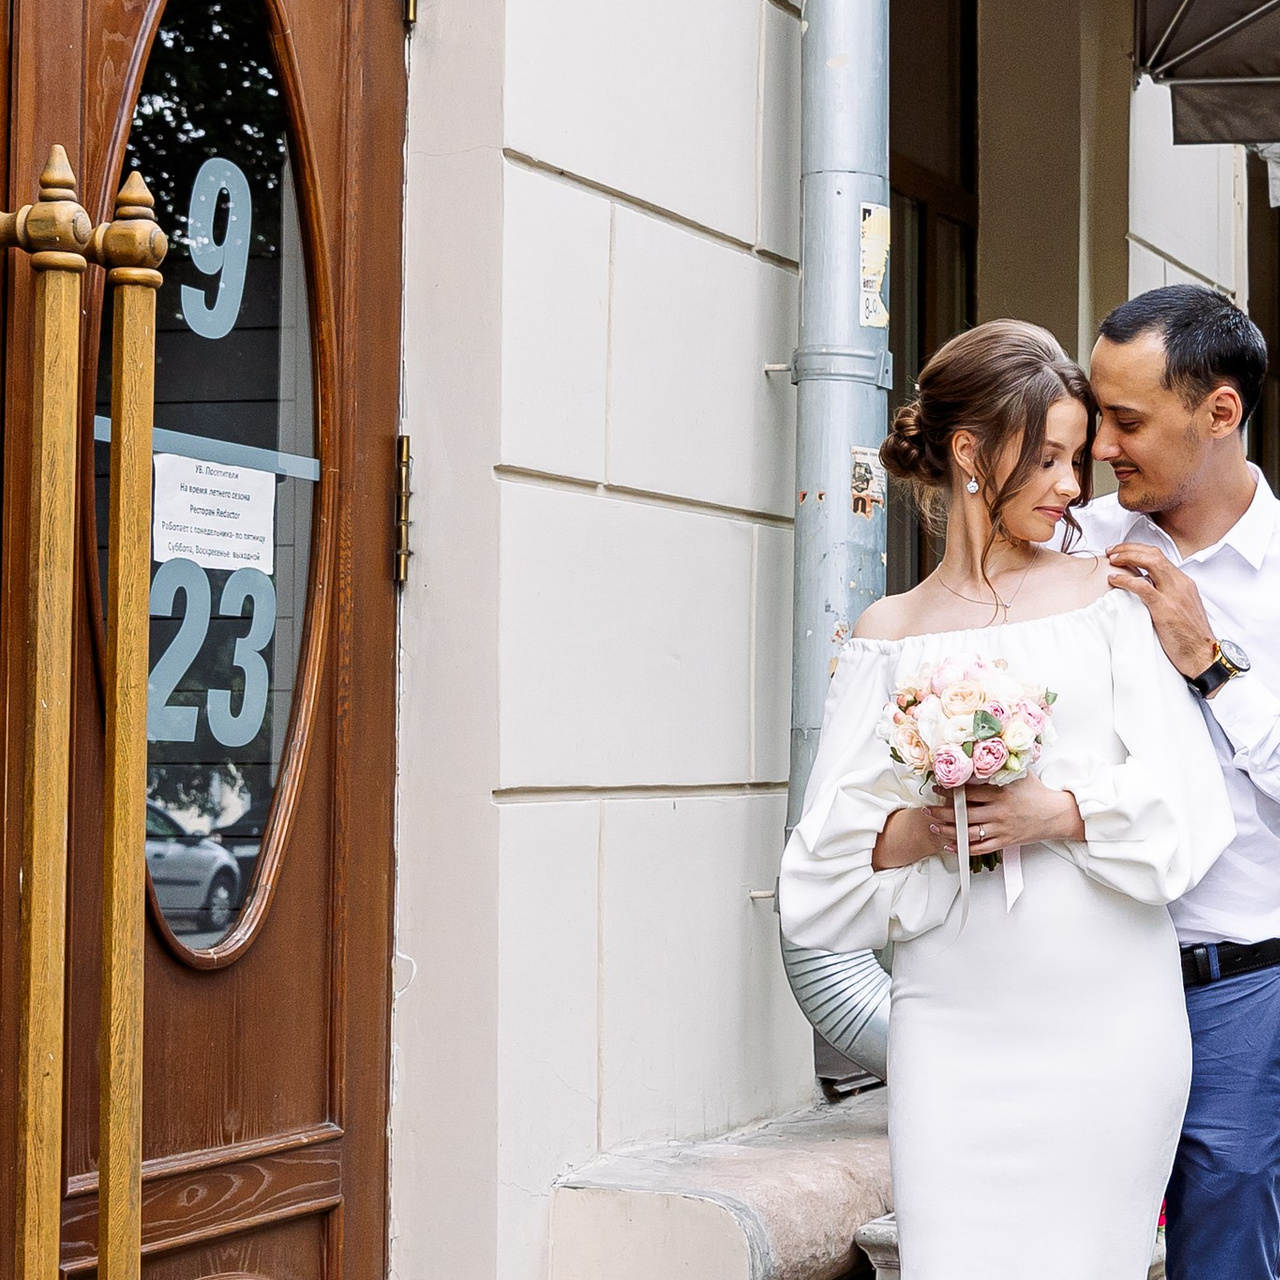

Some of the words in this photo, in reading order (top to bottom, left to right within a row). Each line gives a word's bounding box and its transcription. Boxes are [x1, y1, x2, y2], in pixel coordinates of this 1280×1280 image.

[180, 157, 253, 340] 9
[180, 482, 188, 492] На
[189, 485, 208, 496] время
[208, 488, 231, 498] летнего
[231, 491, 251, 502] сезона
[189, 504, 215, 517] Ресторан
[216, 508, 241, 520] Redactor
[161, 520, 189, 533] Работает
[235, 532, 243, 540] по
[147, 558, 277, 748] 23
